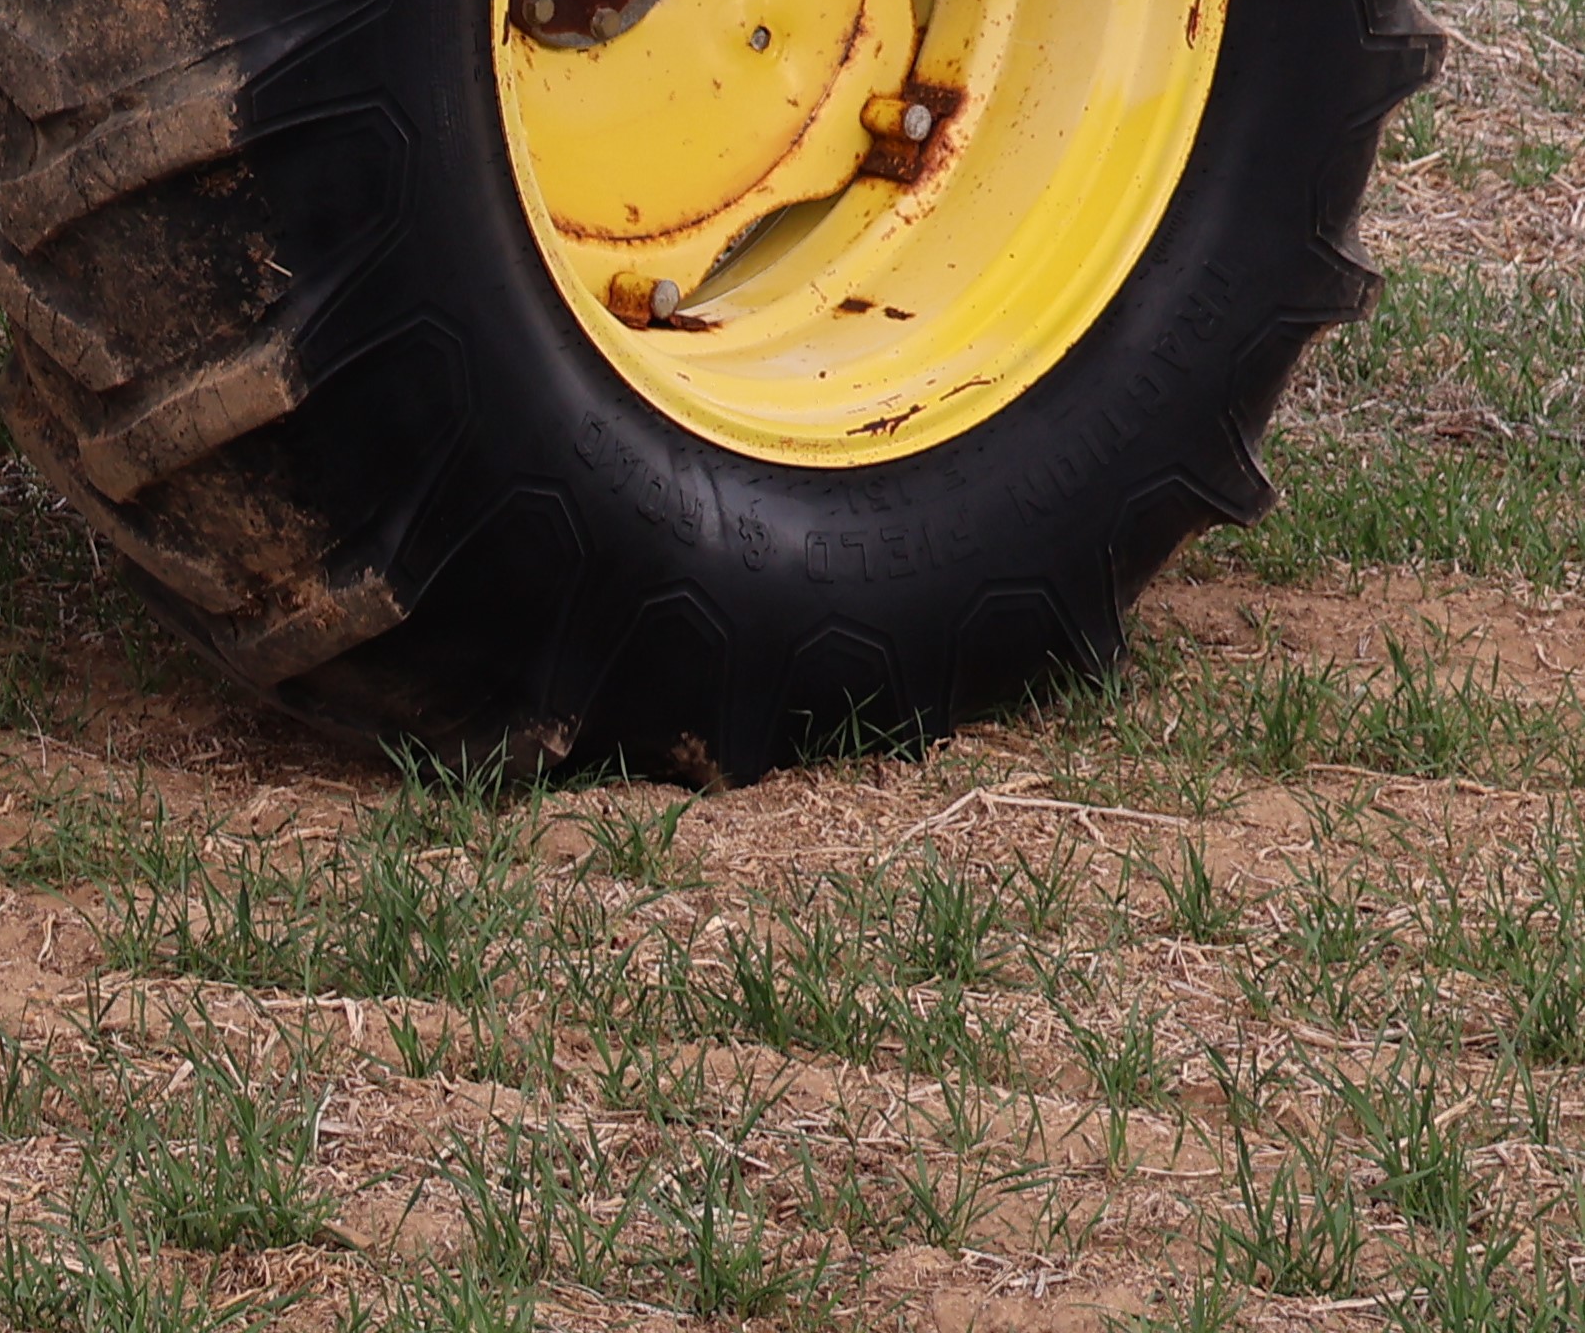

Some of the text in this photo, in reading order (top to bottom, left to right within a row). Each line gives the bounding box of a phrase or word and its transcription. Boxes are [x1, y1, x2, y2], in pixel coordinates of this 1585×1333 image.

[1010, 261, 1242, 529] TRACTION
[575, 409, 705, 547] ROAD
[807, 515, 980, 585] FIELD
